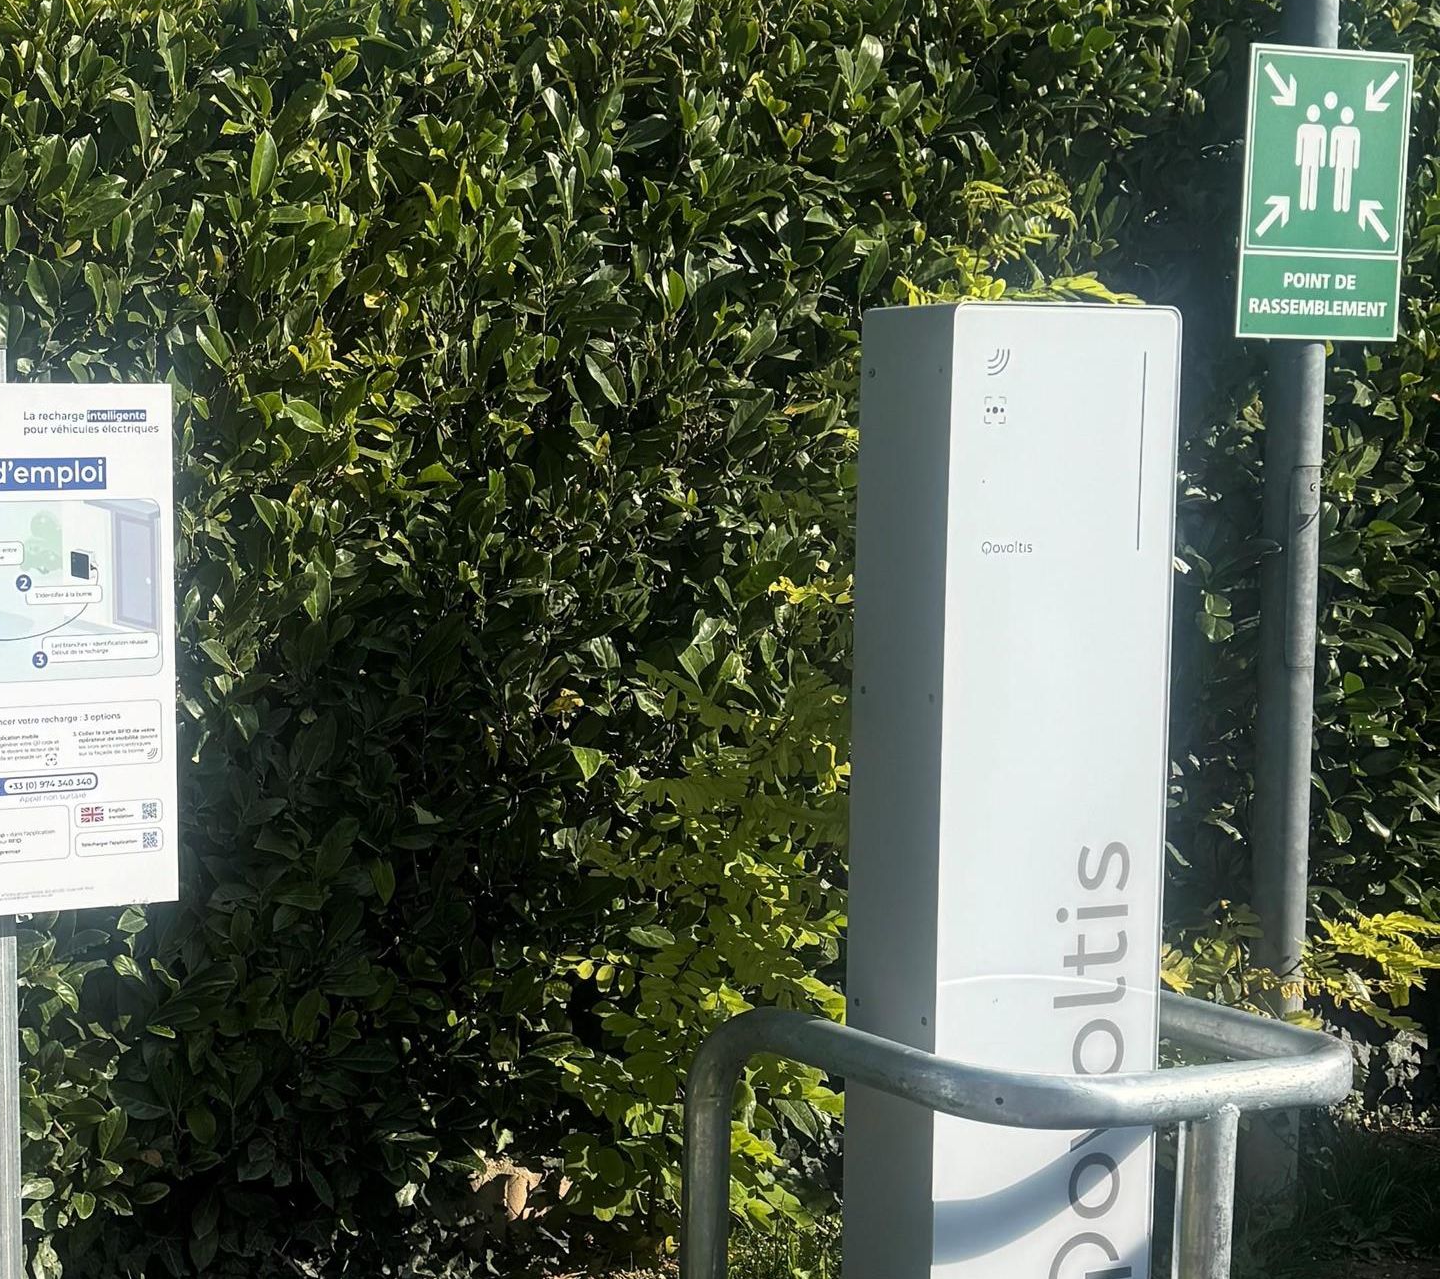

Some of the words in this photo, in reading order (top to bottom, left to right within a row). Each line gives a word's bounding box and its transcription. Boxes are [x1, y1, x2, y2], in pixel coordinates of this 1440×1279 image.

[1283, 272, 1331, 290] POINT
[1335, 274, 1356, 290] DE
[1248, 297, 1388, 318] RASSEMBLEMENT
[23, 410, 35, 421] La
[38, 410, 85, 423] recharge
[87, 409, 147, 422] intelligente
[23, 425, 48, 436] pour
[51, 424, 100, 434] véhicules
[102, 423, 159, 435] électriques
[981, 540, 1033, 556] Qovoltis
[19, 577, 28, 590] 2
[36, 653, 44, 667] 3
[41, 716, 78, 725] recharge
[84, 714, 89, 722] 3
[90, 712, 121, 722] options
[26, 781, 38, 791] (0)
[39, 780, 56, 789] 974
[58, 778, 74, 788] 340
[76, 778, 92, 786] 340
